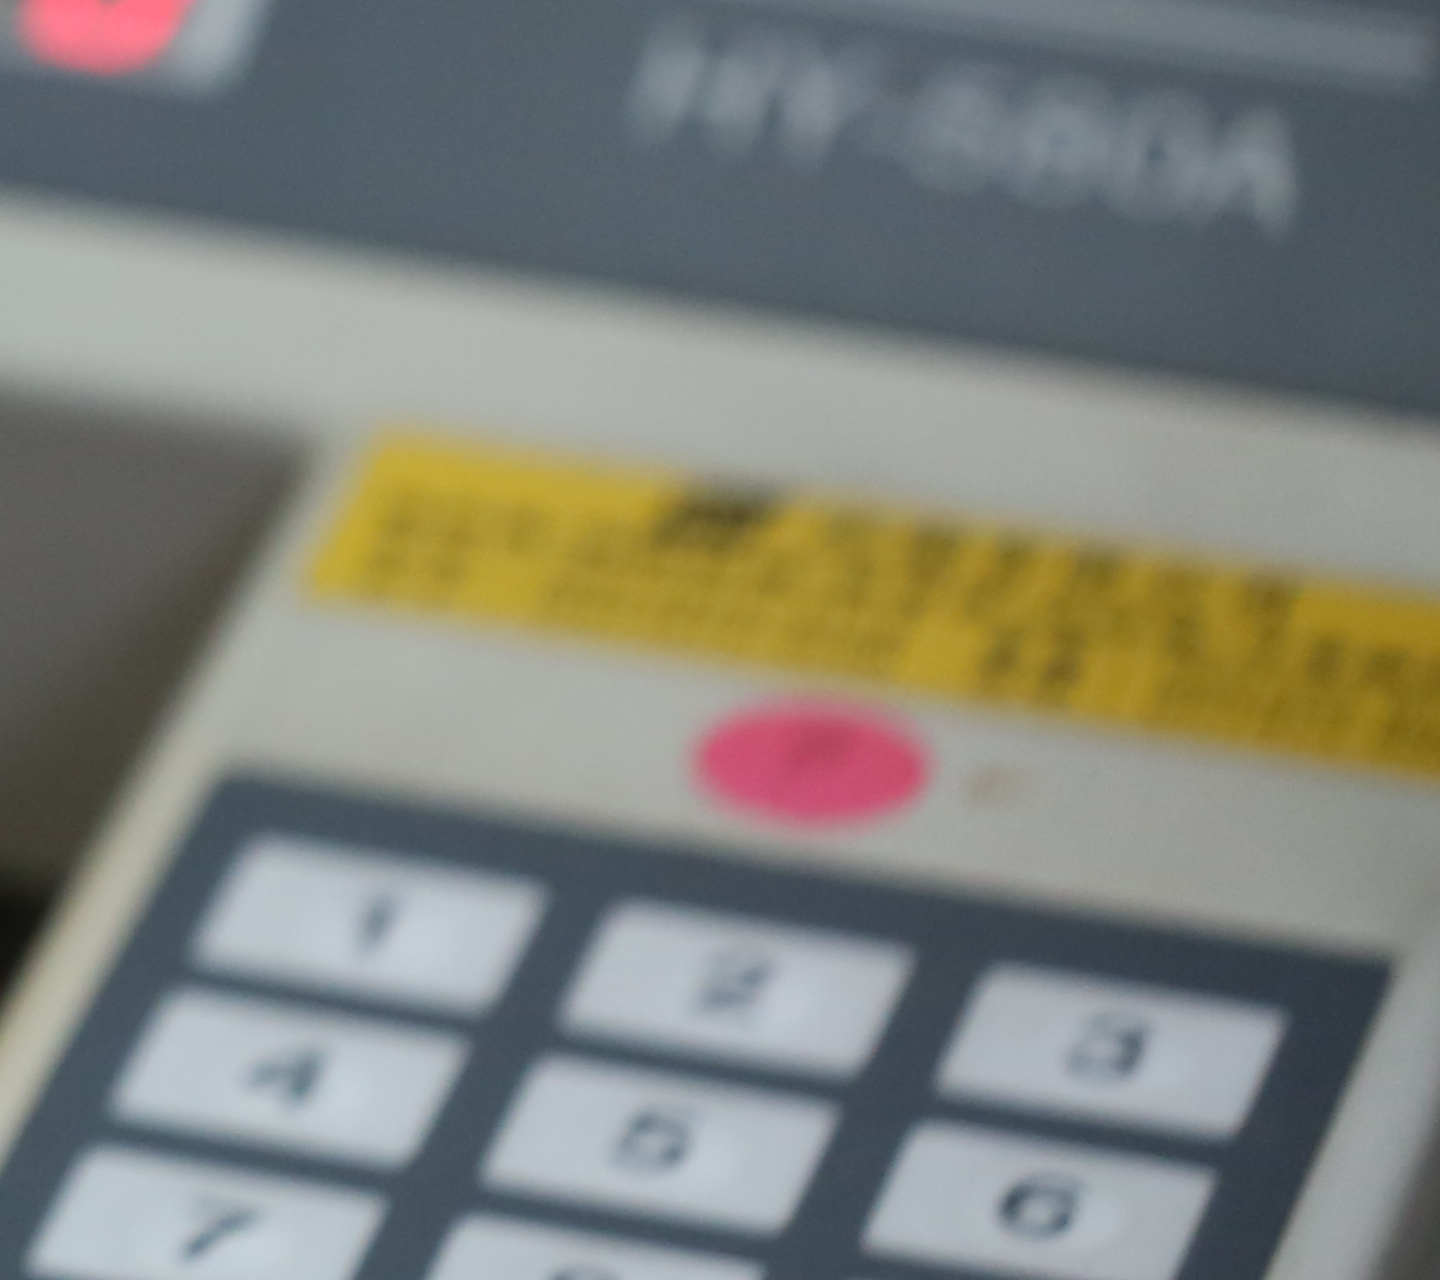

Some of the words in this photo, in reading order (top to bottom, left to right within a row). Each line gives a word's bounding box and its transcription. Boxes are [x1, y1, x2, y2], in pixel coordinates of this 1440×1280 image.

[688, 942, 780, 1022] 2
[242, 1046, 325, 1114] 4
[1066, 1006, 1154, 1086] 3
[608, 1102, 694, 1180] 5
[177, 1192, 270, 1264] 7
[992, 1170, 1084, 1246] 6
